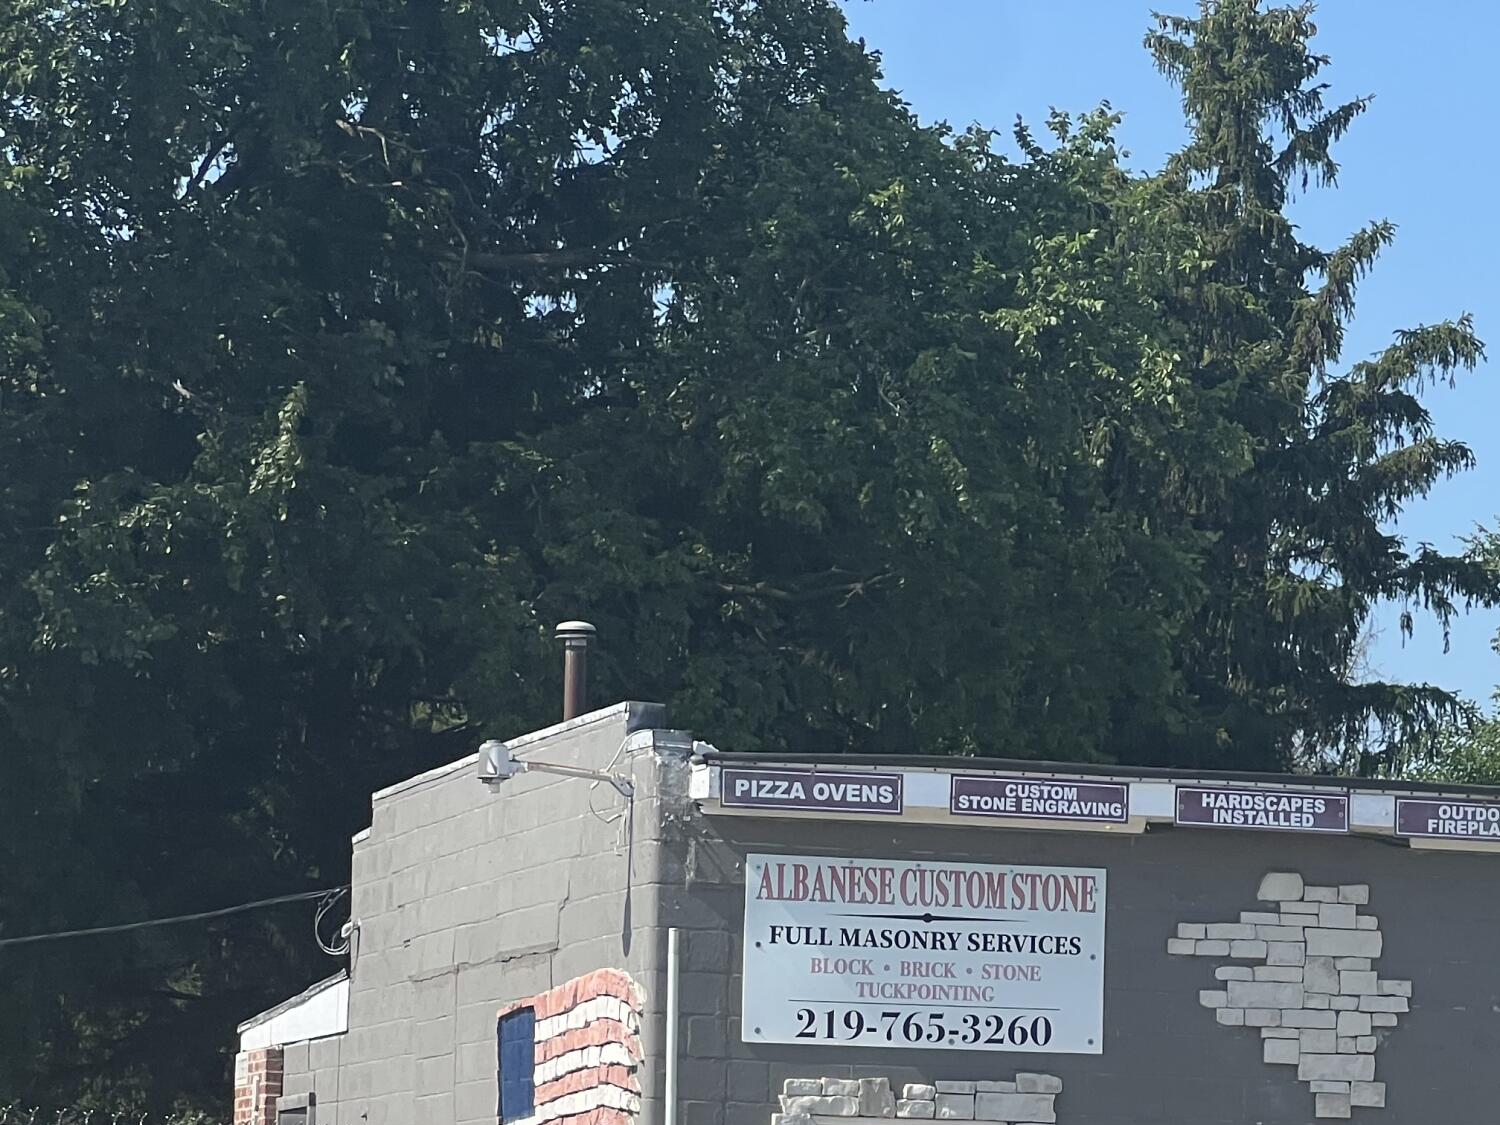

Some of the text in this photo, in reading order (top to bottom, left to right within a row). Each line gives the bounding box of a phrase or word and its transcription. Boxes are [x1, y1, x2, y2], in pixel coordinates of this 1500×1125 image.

[735, 779, 893, 804] PIZZA OVENS
[1005, 784, 1077, 800] CUSTOM
[1201, 792, 1326, 814] HARDSCAPES
[958, 795, 1122, 817] STONE ENGRAVING
[1212, 808, 1315, 828] INSTALLED
[755, 861, 1096, 914] ALBANESE CUSTOM STONE
[768, 925, 1082, 955] FULL MASONRY SERVICES
[810, 957, 1041, 981] BLOCK BRICK STONE
[855, 981, 995, 1002] TUCKPOINTING
[794, 1008, 1052, 1047] 219-765-3260
